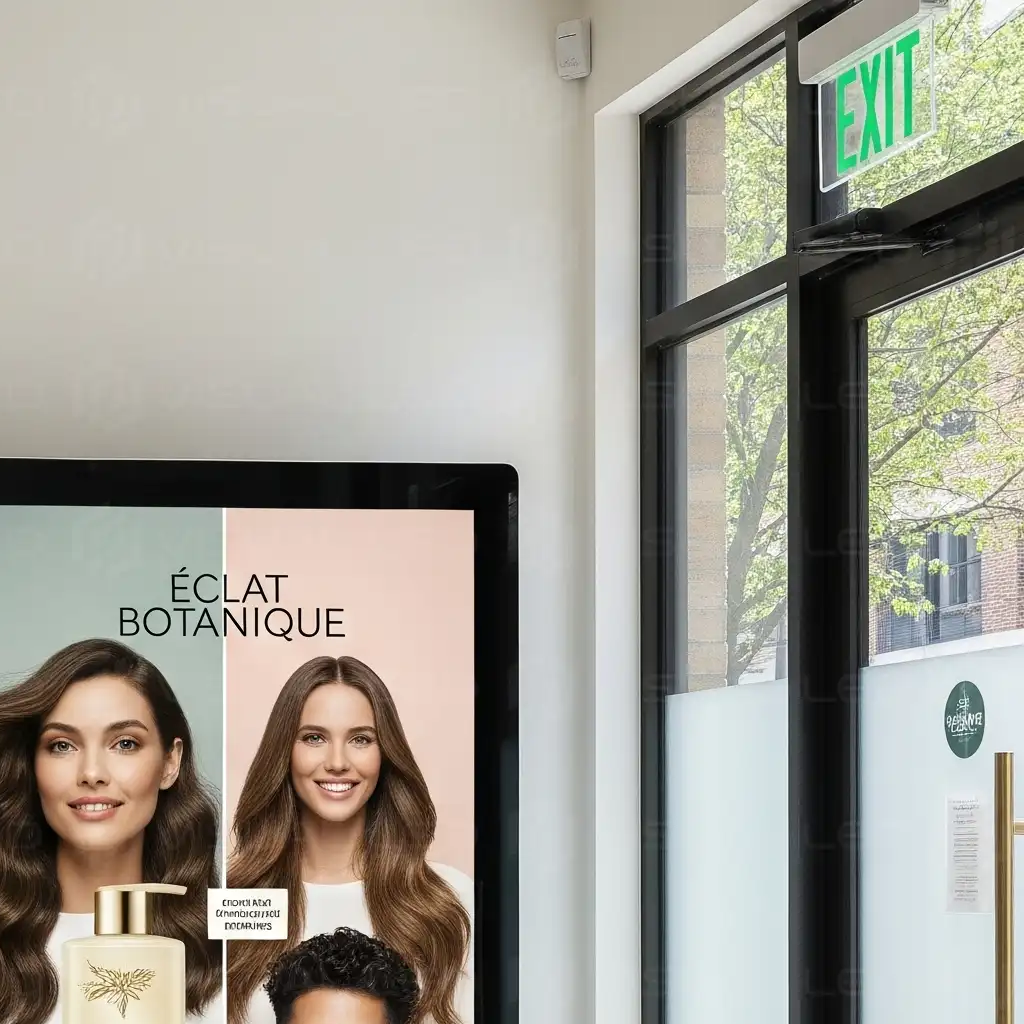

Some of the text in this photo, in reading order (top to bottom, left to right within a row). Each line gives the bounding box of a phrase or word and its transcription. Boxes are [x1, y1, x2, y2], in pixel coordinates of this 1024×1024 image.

[836, 29, 920, 177] EXIT
[171, 566, 289, 604] ÉCLAT
[119, 607, 346, 642] BOTANIQUE
